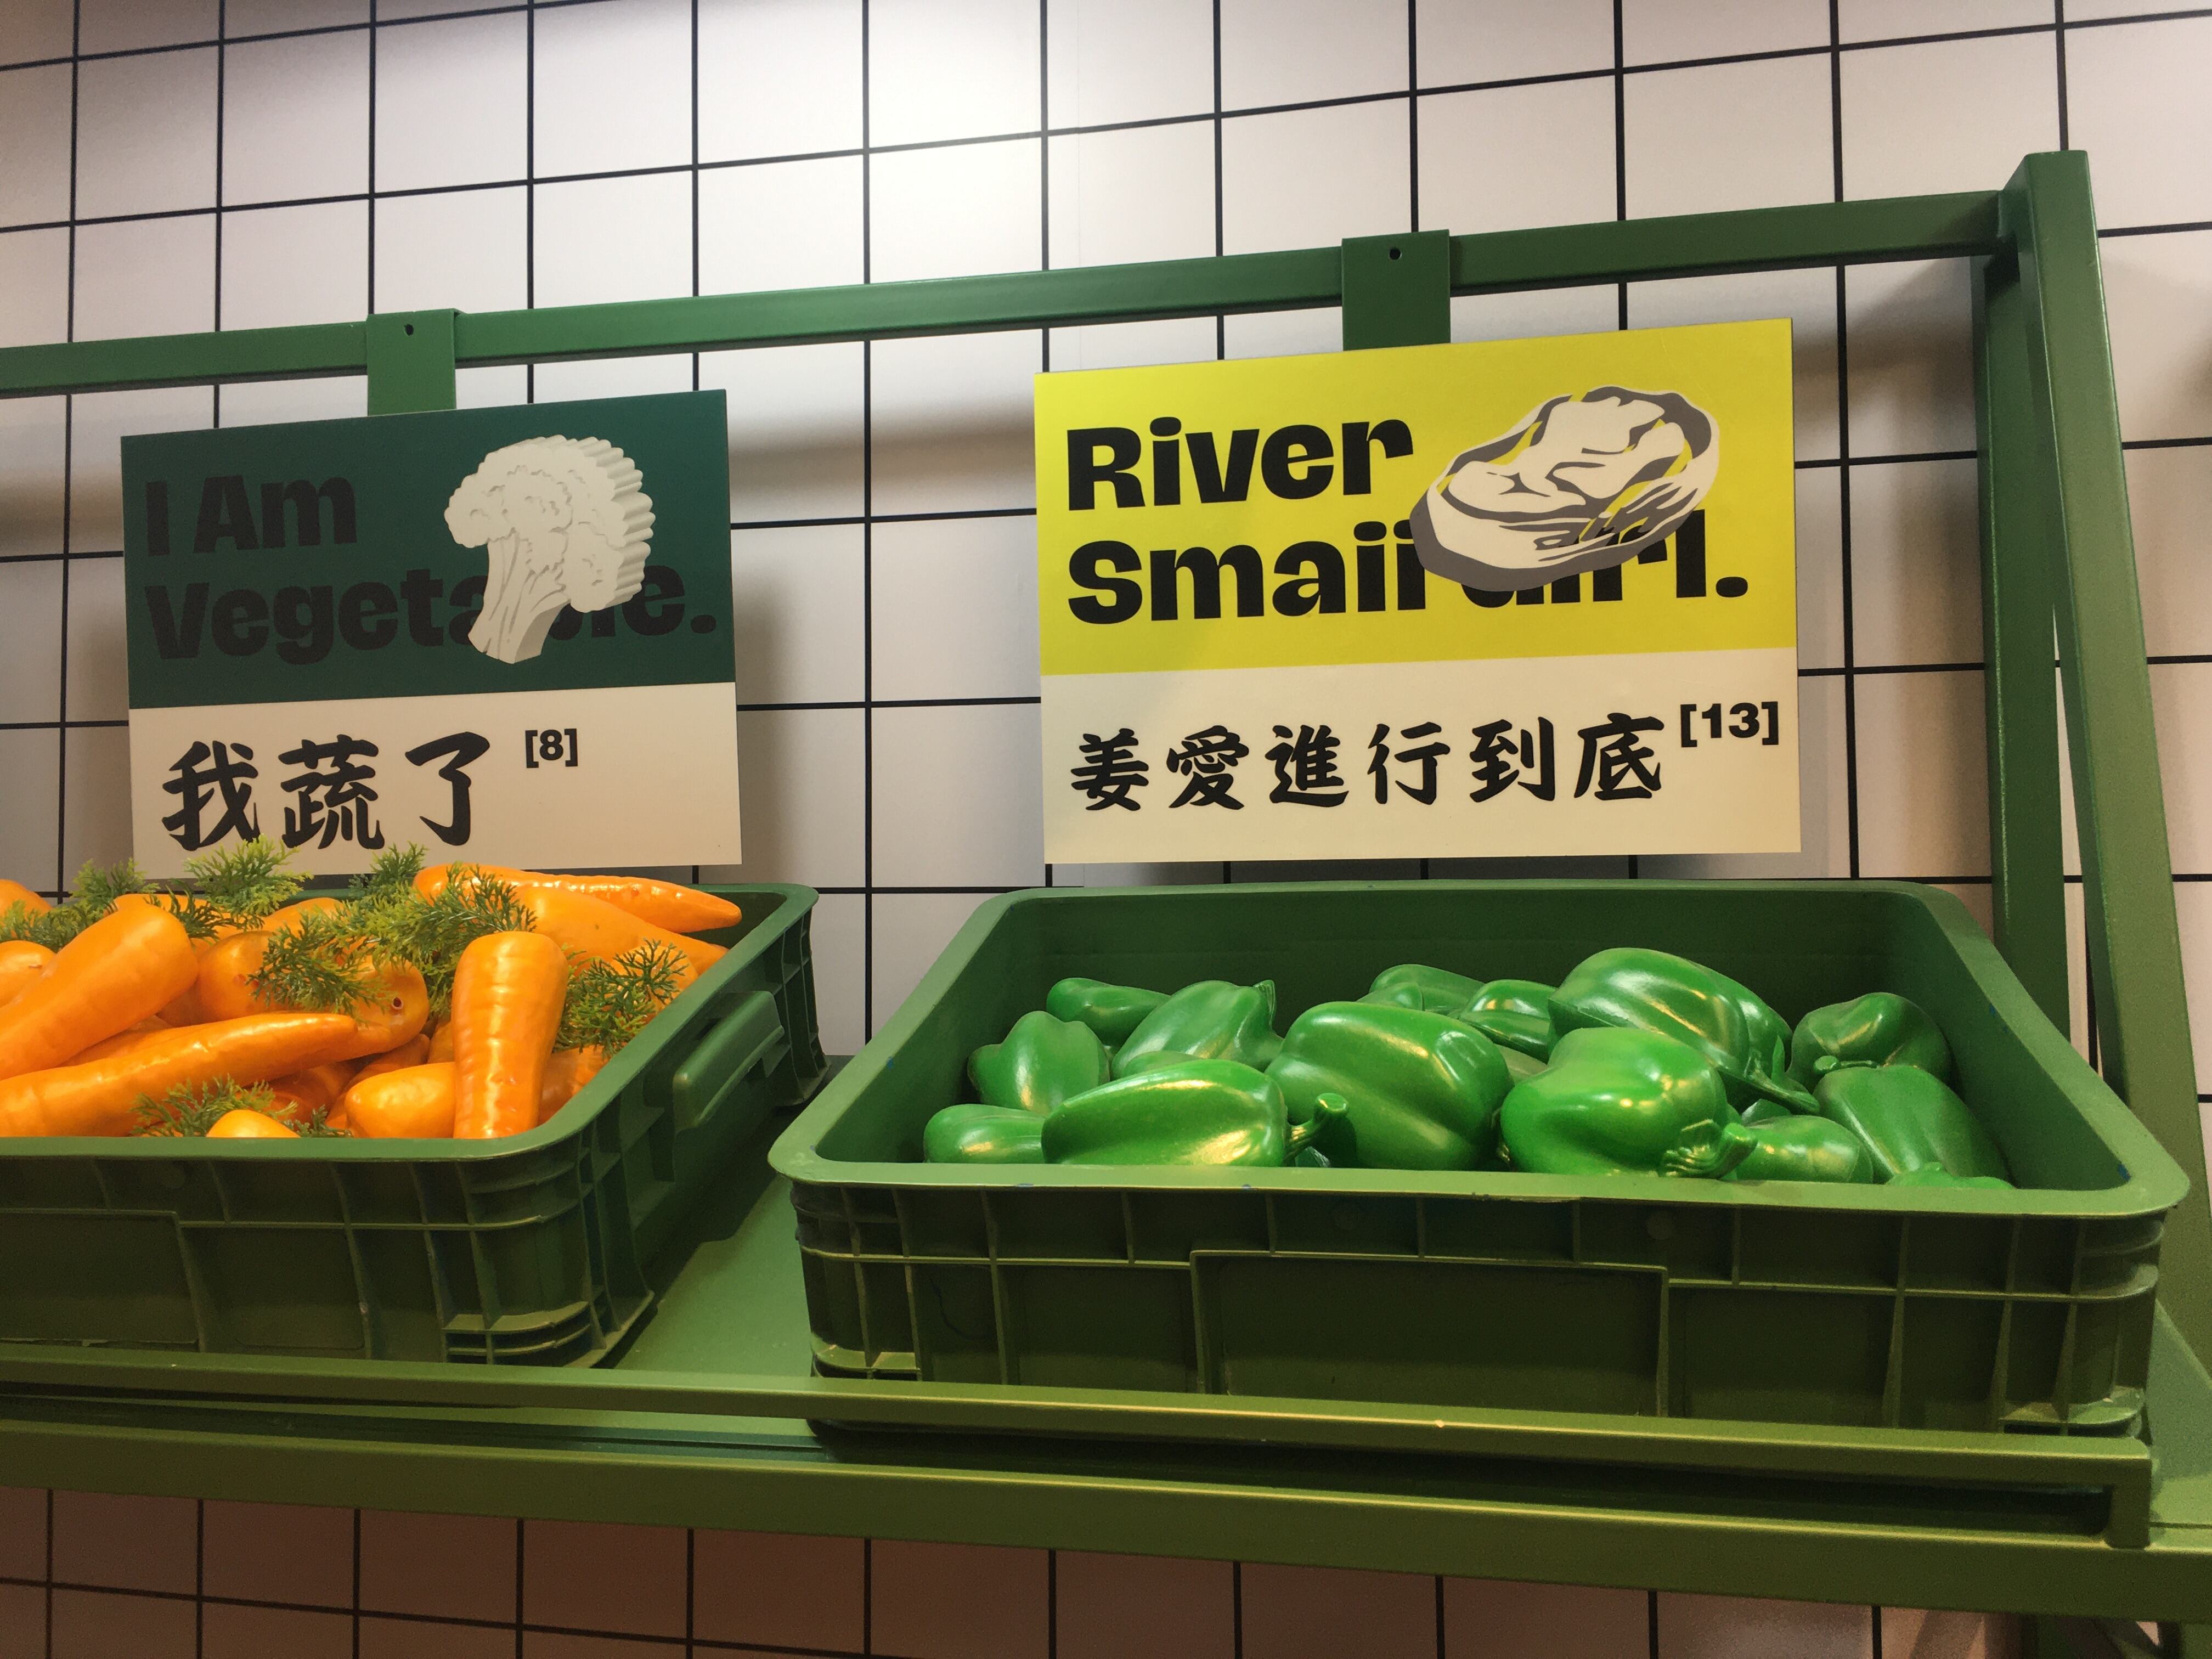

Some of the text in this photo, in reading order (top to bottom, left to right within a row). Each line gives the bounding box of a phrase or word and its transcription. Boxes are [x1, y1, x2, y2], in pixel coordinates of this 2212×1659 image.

[1066, 417, 1413, 511] River
[145, 475, 357, 556] I Am
[162, 729, 579, 851] 我蔬了 [8]
[1070, 701, 1779, 812] 姜愛進行到底 [13]
